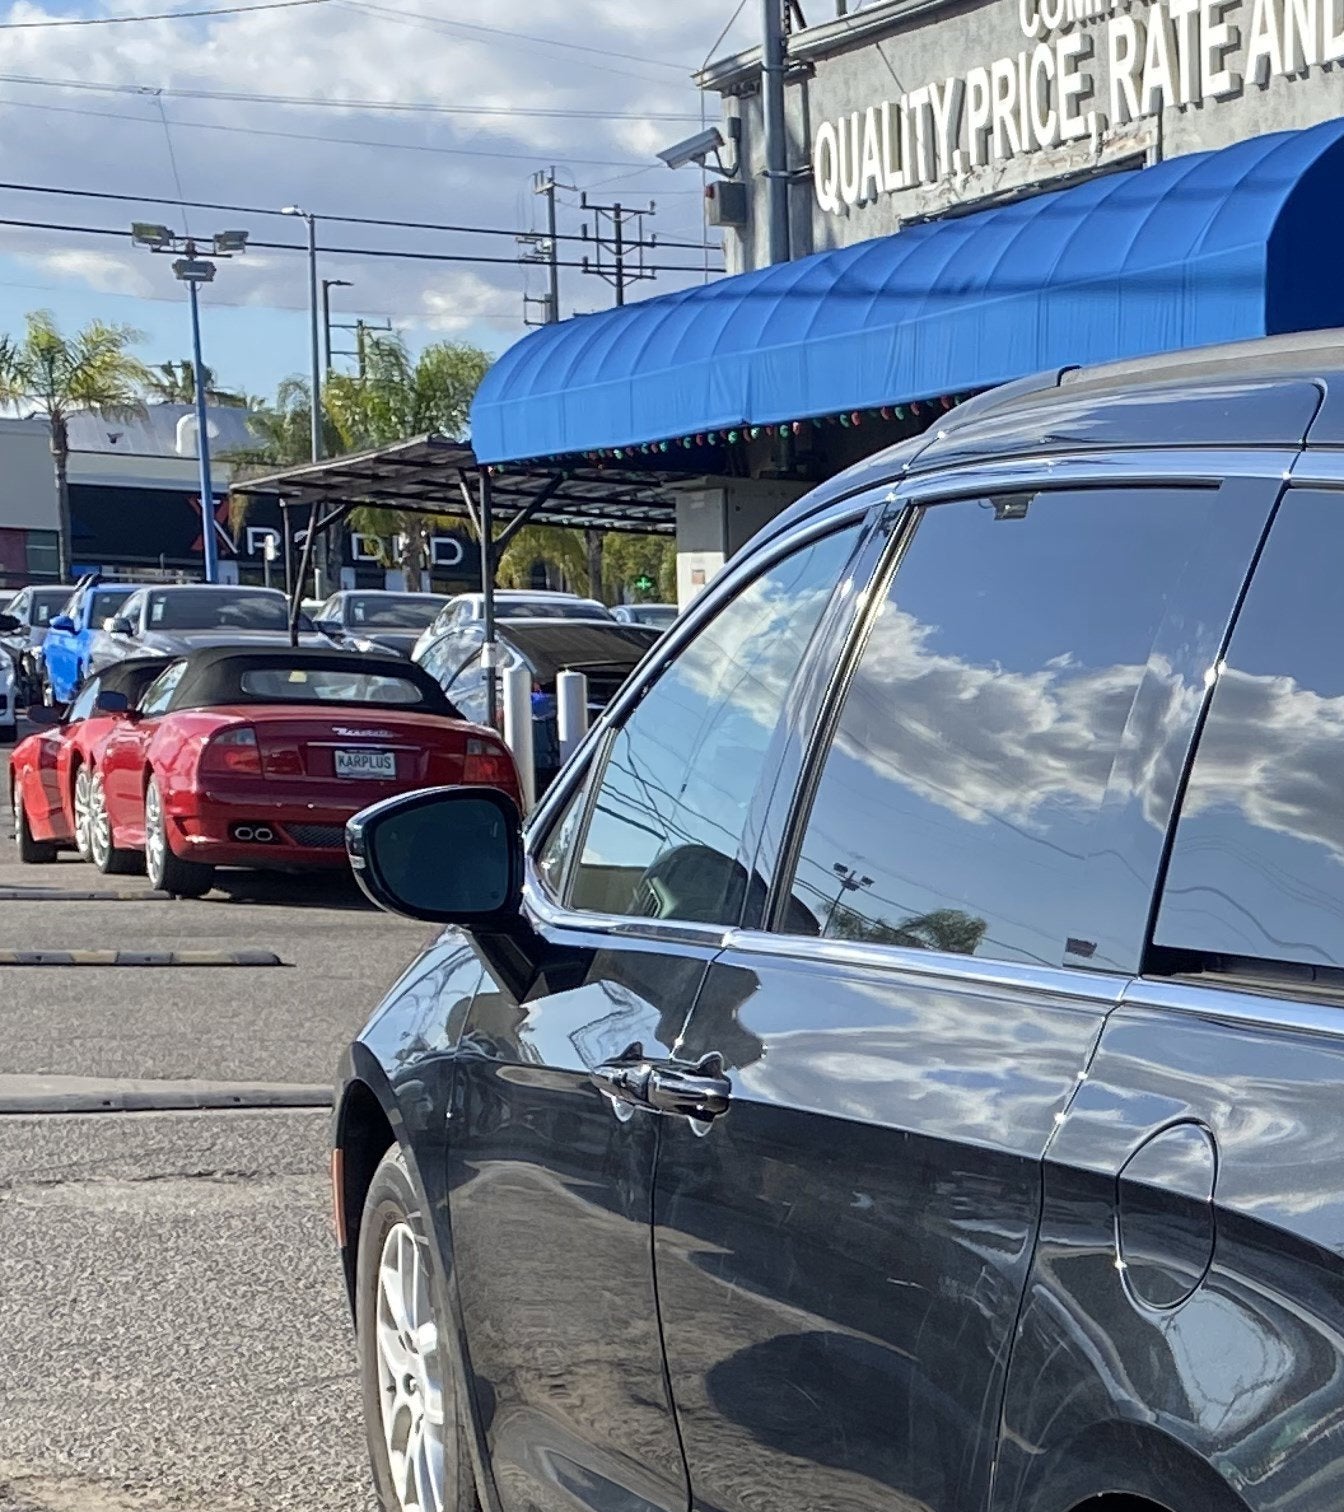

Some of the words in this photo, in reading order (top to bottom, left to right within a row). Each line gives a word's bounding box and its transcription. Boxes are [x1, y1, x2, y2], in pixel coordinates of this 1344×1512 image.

[813, 77, 967, 216] QUALITY,
[967, 32, 1102, 166] PRICE,
[1108, 0, 1235, 124] RATE
[338, 754, 392, 770] KARPLUS
